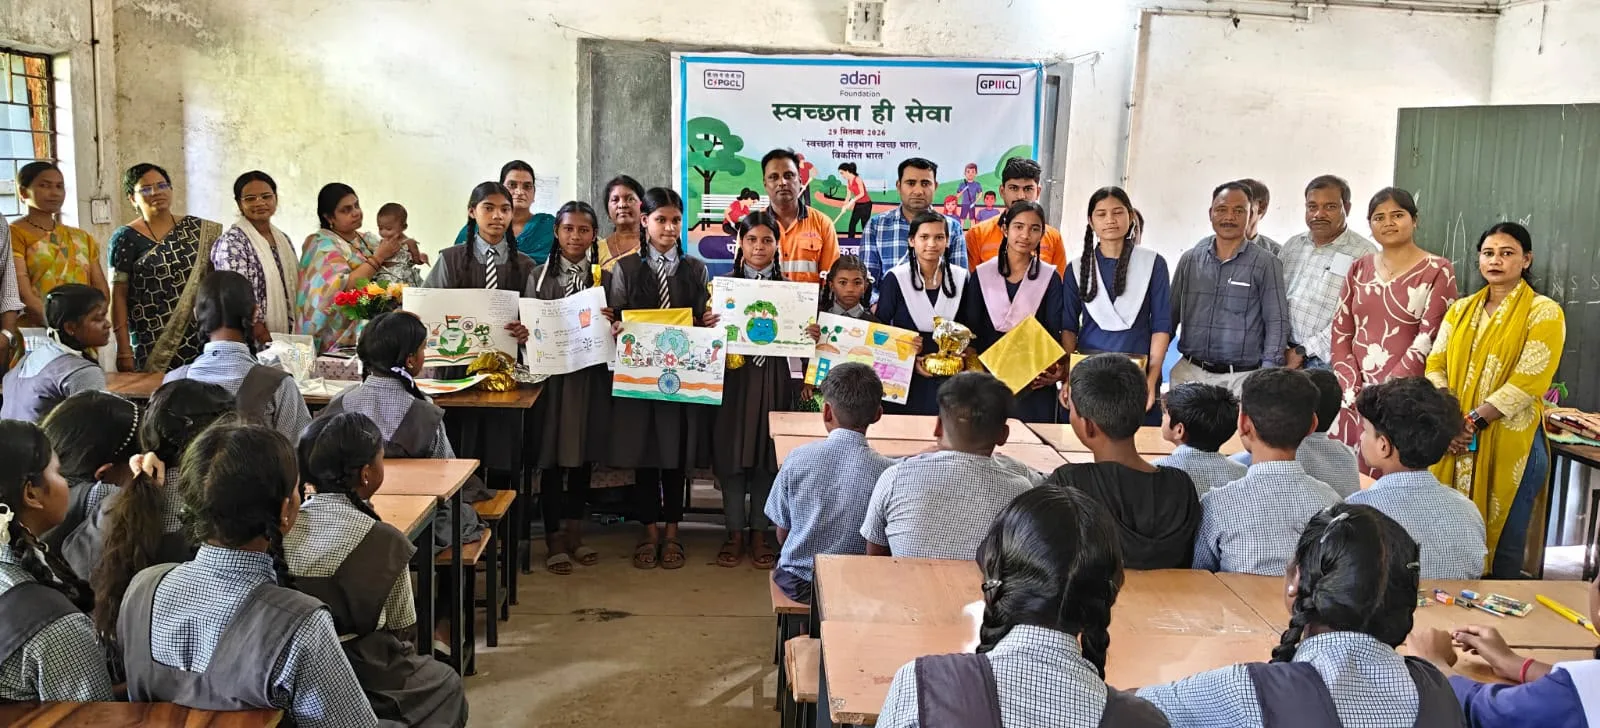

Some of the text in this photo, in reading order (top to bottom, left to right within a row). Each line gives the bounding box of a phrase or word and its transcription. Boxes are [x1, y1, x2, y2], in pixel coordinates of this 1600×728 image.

[840, 71, 881, 85] adani
[840, 90, 881, 98] Foundation
[772, 98, 952, 124] स्वच्छता ही सेवा
[832, 149, 862, 160] विकसित
